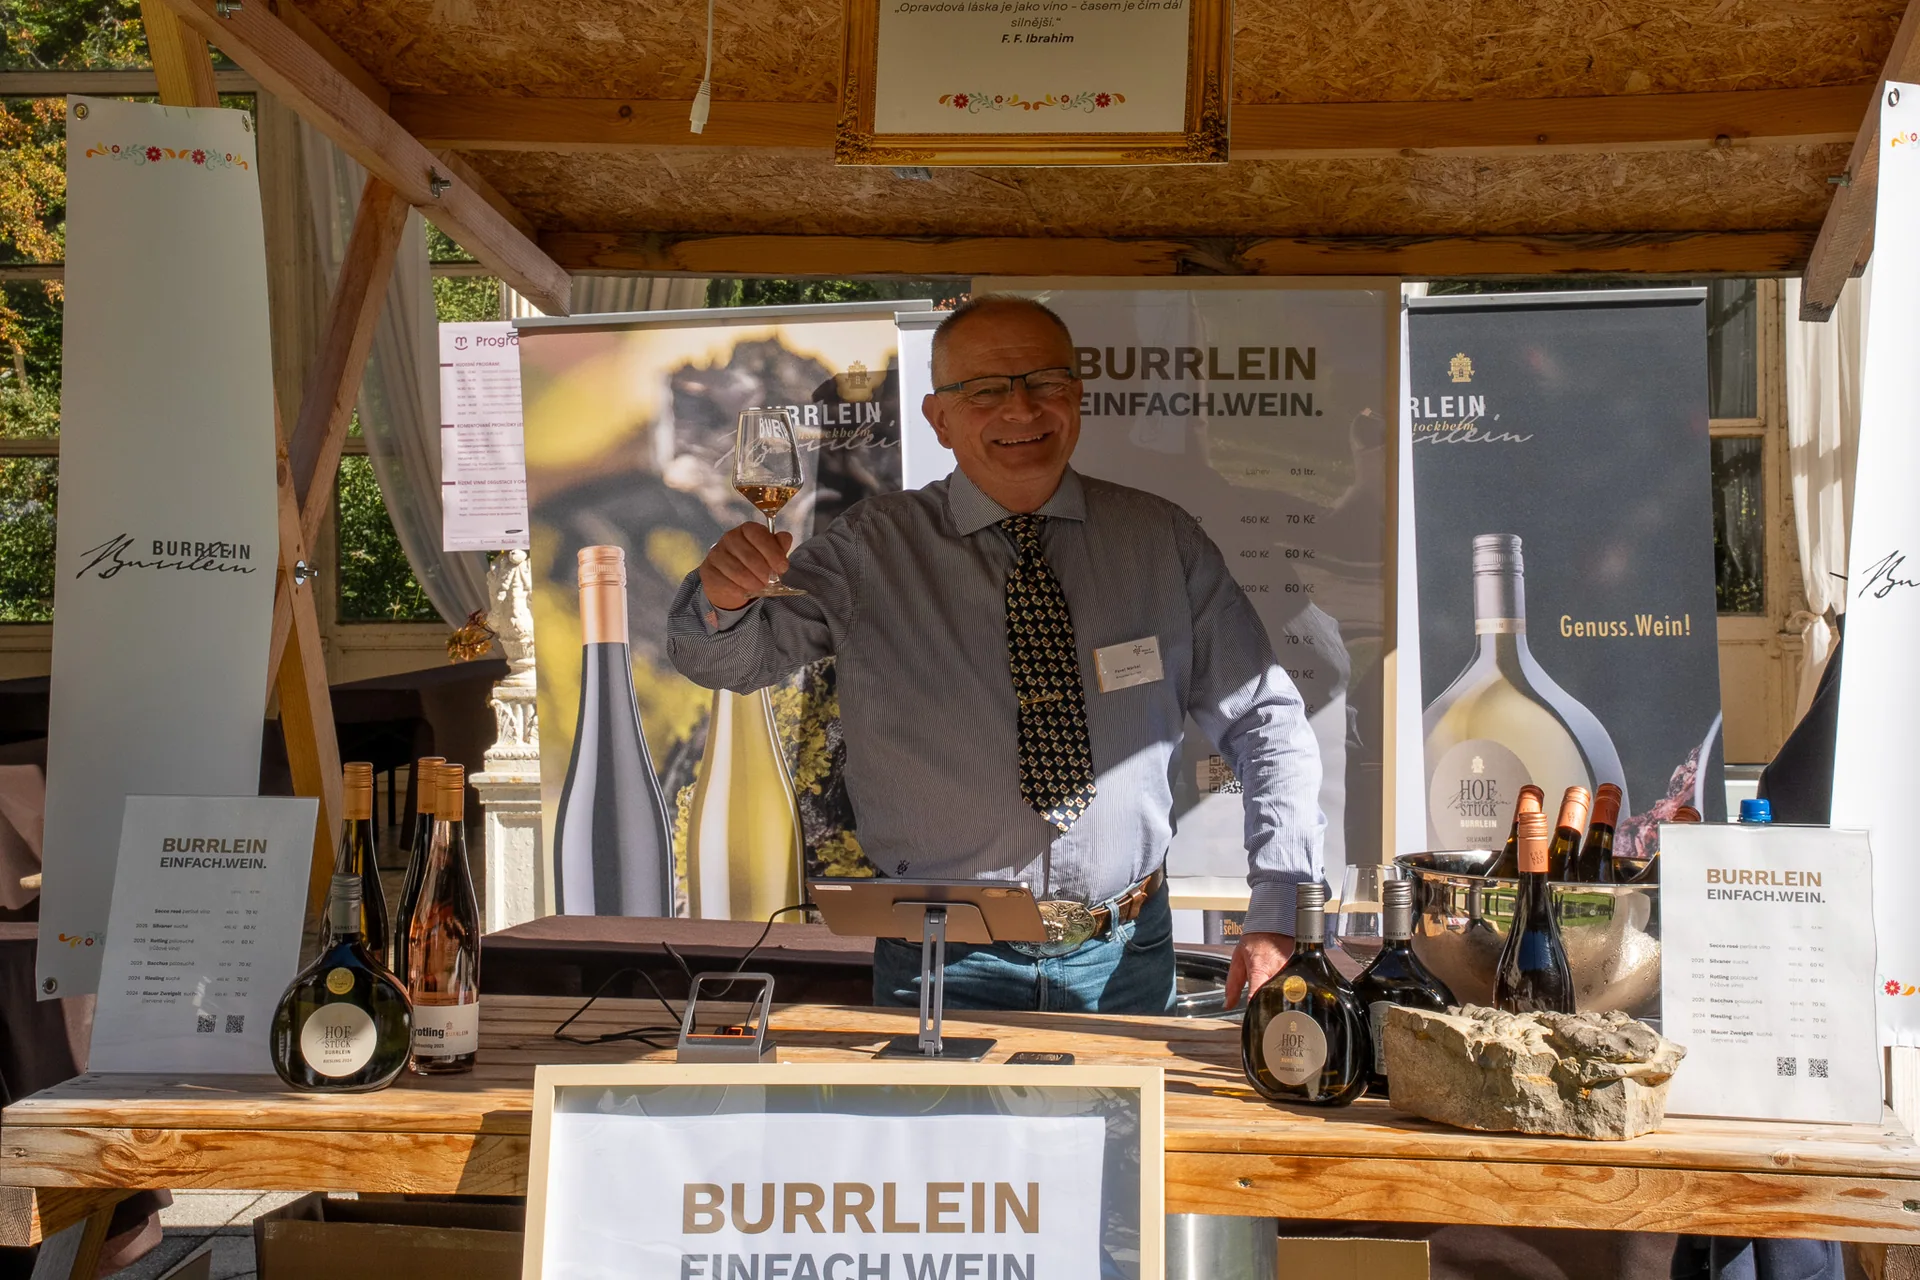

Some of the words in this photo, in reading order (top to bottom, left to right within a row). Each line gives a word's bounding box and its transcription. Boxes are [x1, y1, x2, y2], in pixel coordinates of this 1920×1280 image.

[894, 2, 965, 14] „Opravdová
[968, 1, 998, 12] láska
[1000, 2, 1012, 14] je
[1013, 2, 1040, 14] jako
[1043, 1, 1068, 11] víno
[1080, 0, 1120, 11] časem
[1122, 0, 1134, 12] je
[1138, 0, 1160, 10] čím
[1163, 0, 1183, 10] dál
[1002, 34, 1010, 43] F.
[1014, 34, 1022, 43] F.
[1026, 32, 1074, 43] Ibrahim
[1076, 347, 1316, 380] BURRLEIN
[1080, 392, 1324, 417] EINFACH.WEIN.
[1290, 468, 1301, 476] 0,1
[1240, 516, 1257, 524] 450
[1260, 515, 1270, 524] Kč
[1286, 514, 1300, 524] 70
[1303, 514, 1316, 524] Kč
[152, 540, 251, 560] BURRLEIN
[1240, 550, 1257, 558] 400
[1260, 550, 1270, 558] Kč
[1285, 549, 1300, 559] 60
[1303, 548, 1315, 559] Kč
[1241, 584, 1257, 592] 400
[1260, 584, 1270, 592] Kč
[1285, 584, 1300, 593] 60
[1303, 583, 1315, 593] Kč
[1560, 614, 1691, 637] Genuss.Wein!
[1285, 636, 1299, 644] 70
[1303, 635, 1314, 645] Kč
[1286, 670, 1299, 679] 70
[1303, 669, 1314, 679] Kč
[1460, 780, 1496, 801] HOF
[162, 838, 268, 854] BURRLEIN
[160, 856, 267, 869] EINFACH.WEIN.
[1706, 868, 1822, 887] BURRLEIN
[1707, 888, 1826, 903] EINFACH.WEIN.
[325, 1026, 352, 1039] HOF
[414, 1028, 444, 1039] rotling
[682, 1182, 1040, 1234] BURRLEIN
